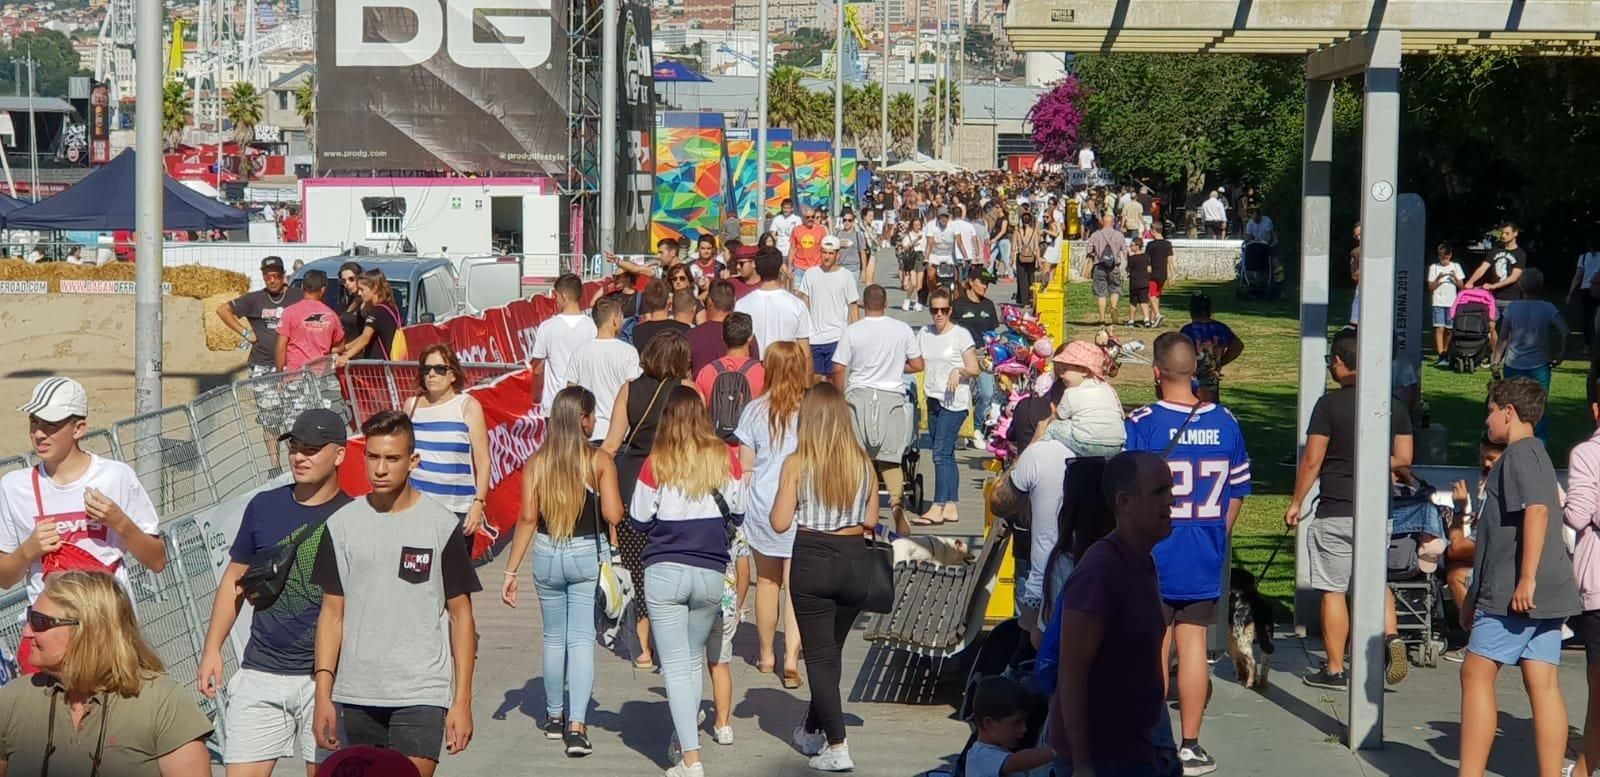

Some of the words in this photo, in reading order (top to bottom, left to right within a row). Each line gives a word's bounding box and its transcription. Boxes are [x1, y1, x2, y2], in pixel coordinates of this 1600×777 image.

[323, 150, 387, 158] www.prodg.com
[1398, 270, 1408, 292] 2013
[1167, 459, 1230, 519] 27
